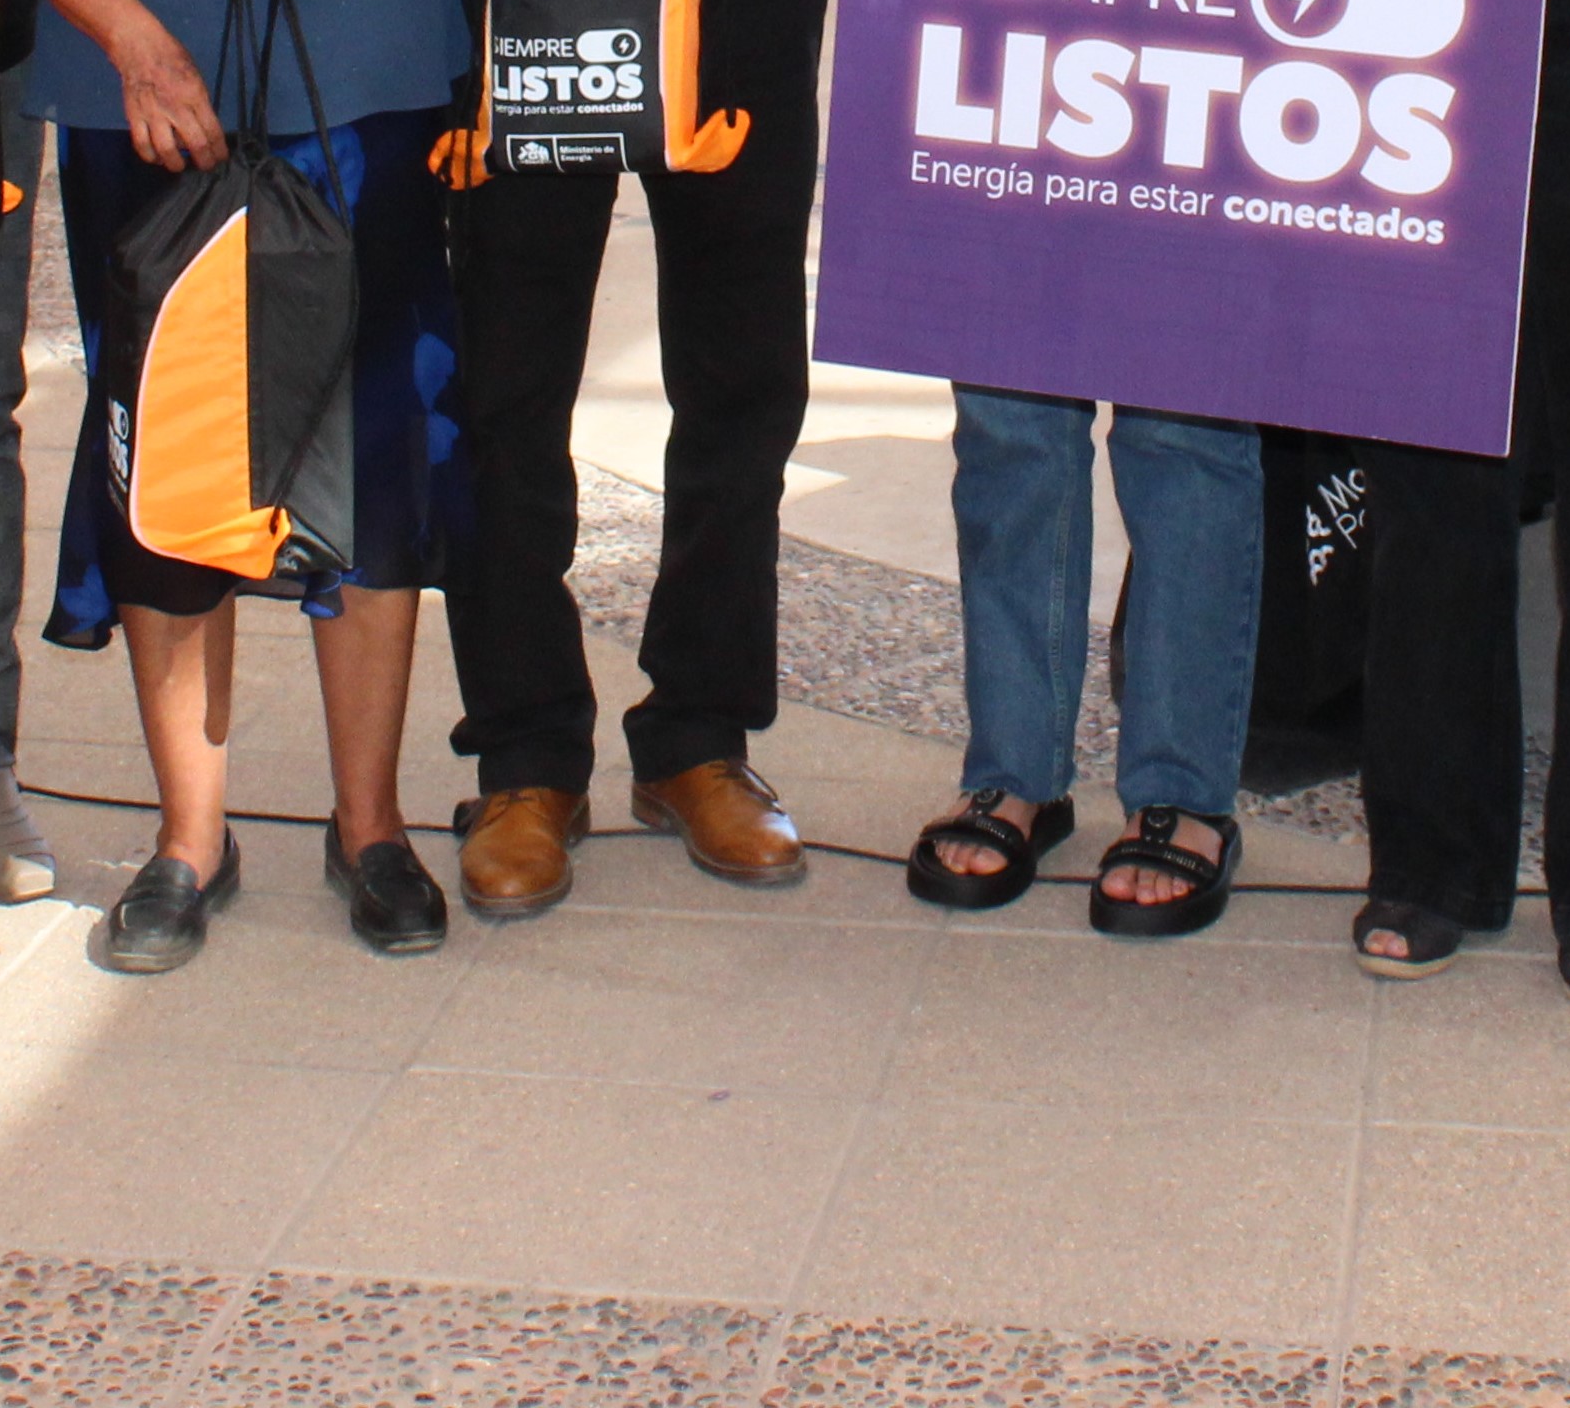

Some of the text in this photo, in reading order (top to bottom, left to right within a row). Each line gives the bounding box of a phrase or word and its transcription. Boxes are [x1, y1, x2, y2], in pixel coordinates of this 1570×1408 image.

[492, 62, 644, 102] LISTOS
[524, 105, 547, 117] para
[549, 103, 575, 114] estar
[577, 100, 645, 114] conectados
[914, 22, 1456, 195] LISTOS
[559, 145, 615, 154] Ministerio de
[910, 150, 1445, 245] Energía para estar conectados
